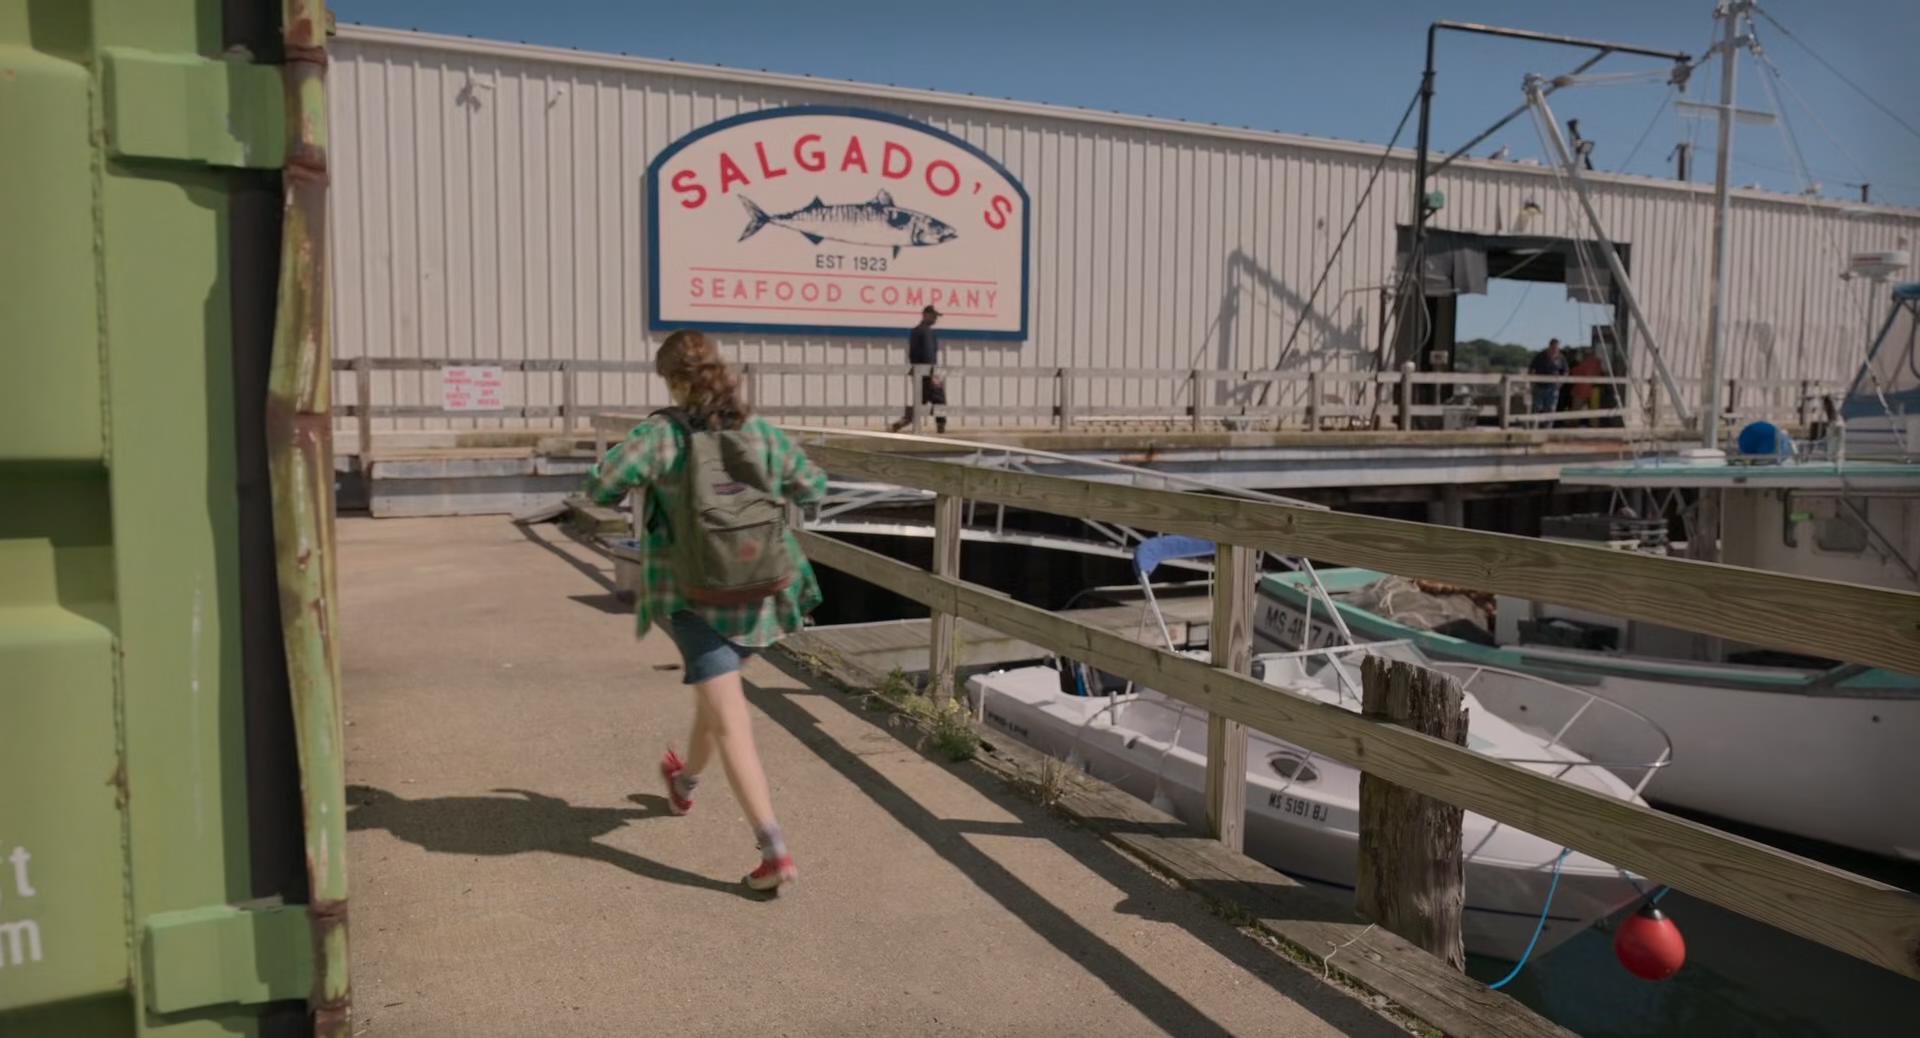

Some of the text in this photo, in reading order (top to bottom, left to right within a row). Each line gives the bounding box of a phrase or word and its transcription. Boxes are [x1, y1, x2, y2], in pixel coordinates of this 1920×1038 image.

[671, 134, 1013, 230] SALGADO'S
[816, 255, 888, 272] EST 1923
[690, 278, 998, 308] SEAFOOD COMPANY
[1264, 605, 1288, 635] MS
[1288, 618, 1322, 645] 417
[1268, 792, 1282, 809] MS
[1285, 798, 1310, 817] 5191
